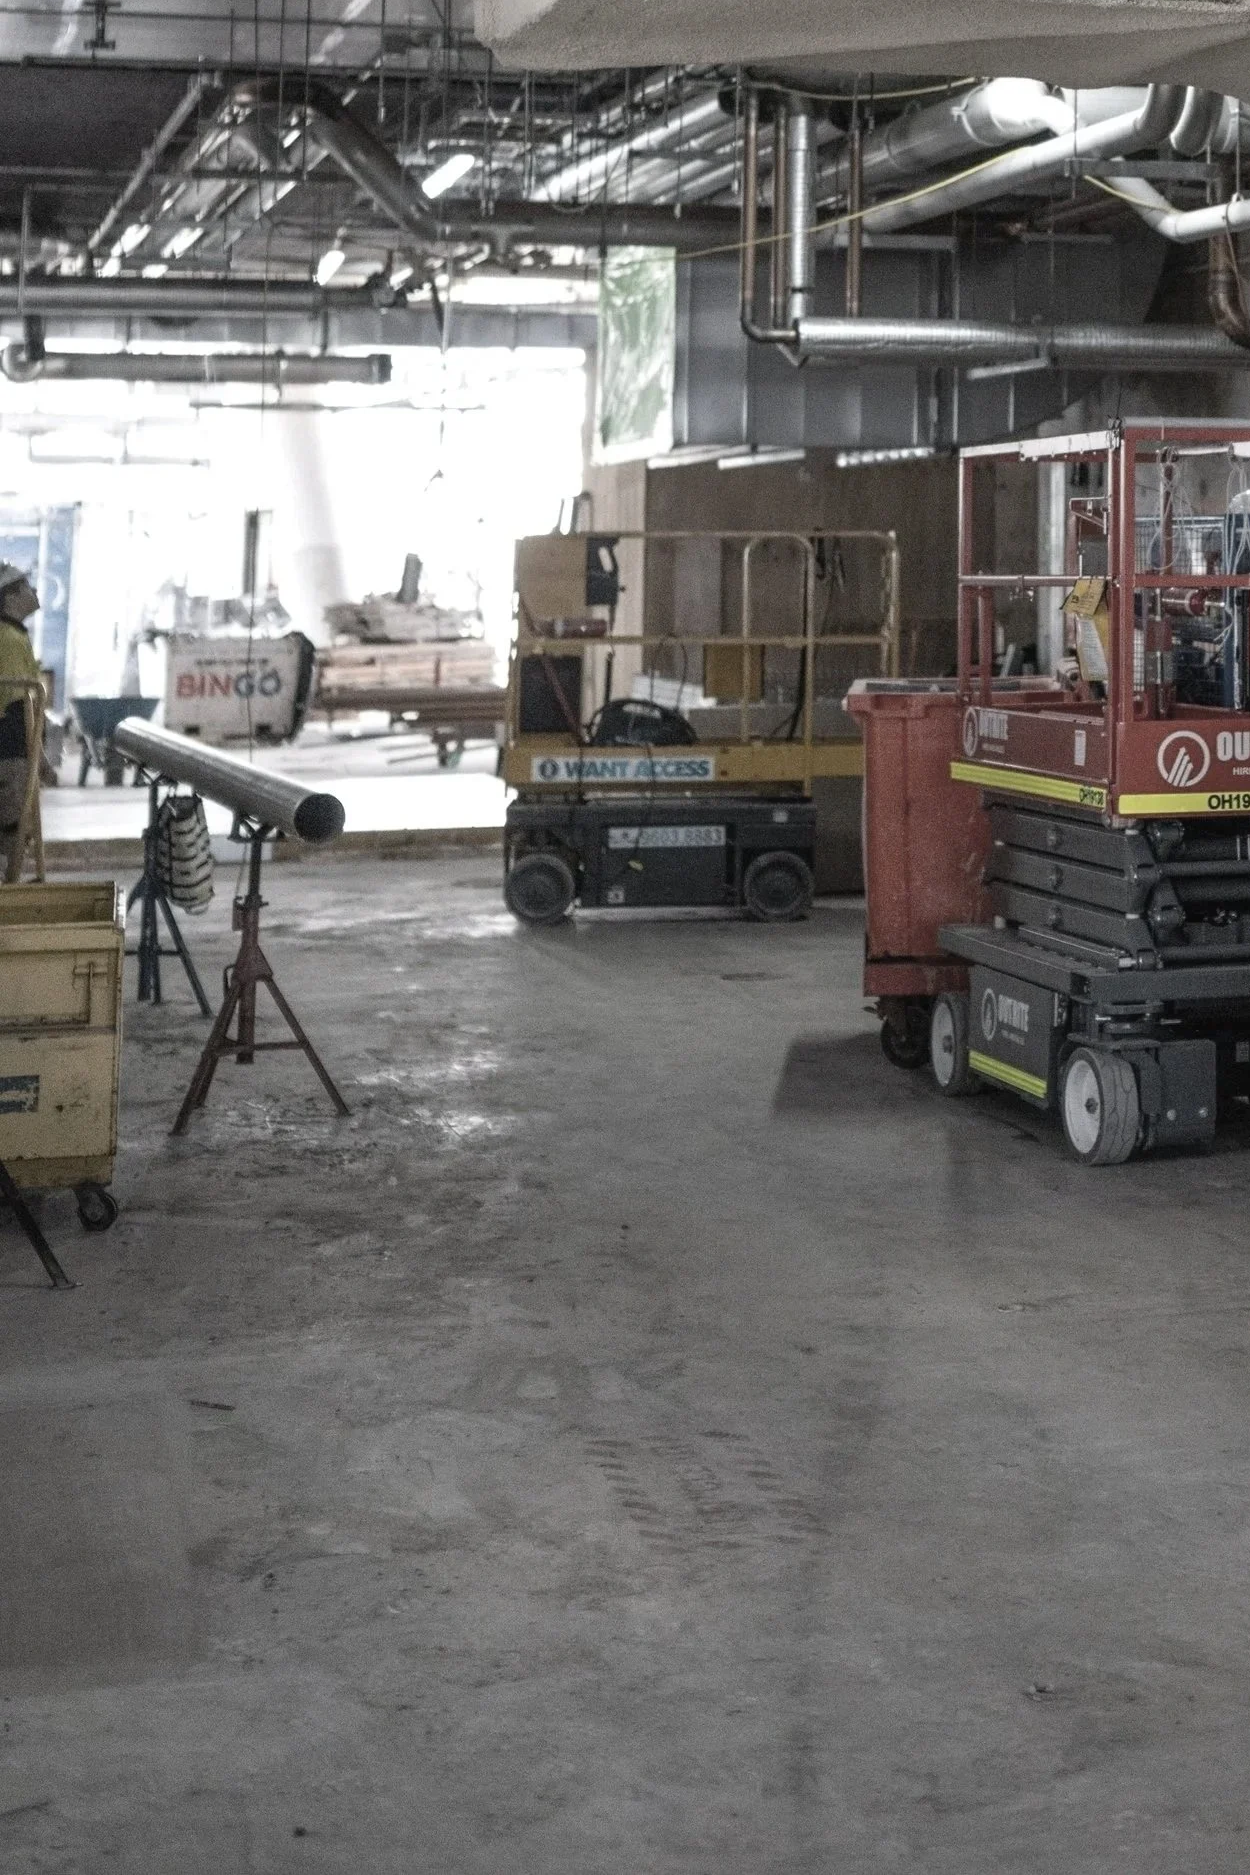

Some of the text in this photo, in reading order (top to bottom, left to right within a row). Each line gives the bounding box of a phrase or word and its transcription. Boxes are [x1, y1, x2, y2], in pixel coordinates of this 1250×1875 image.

[177, 669, 281, 698] BINGO
[565, 759, 710, 777] WANT ACCESS
